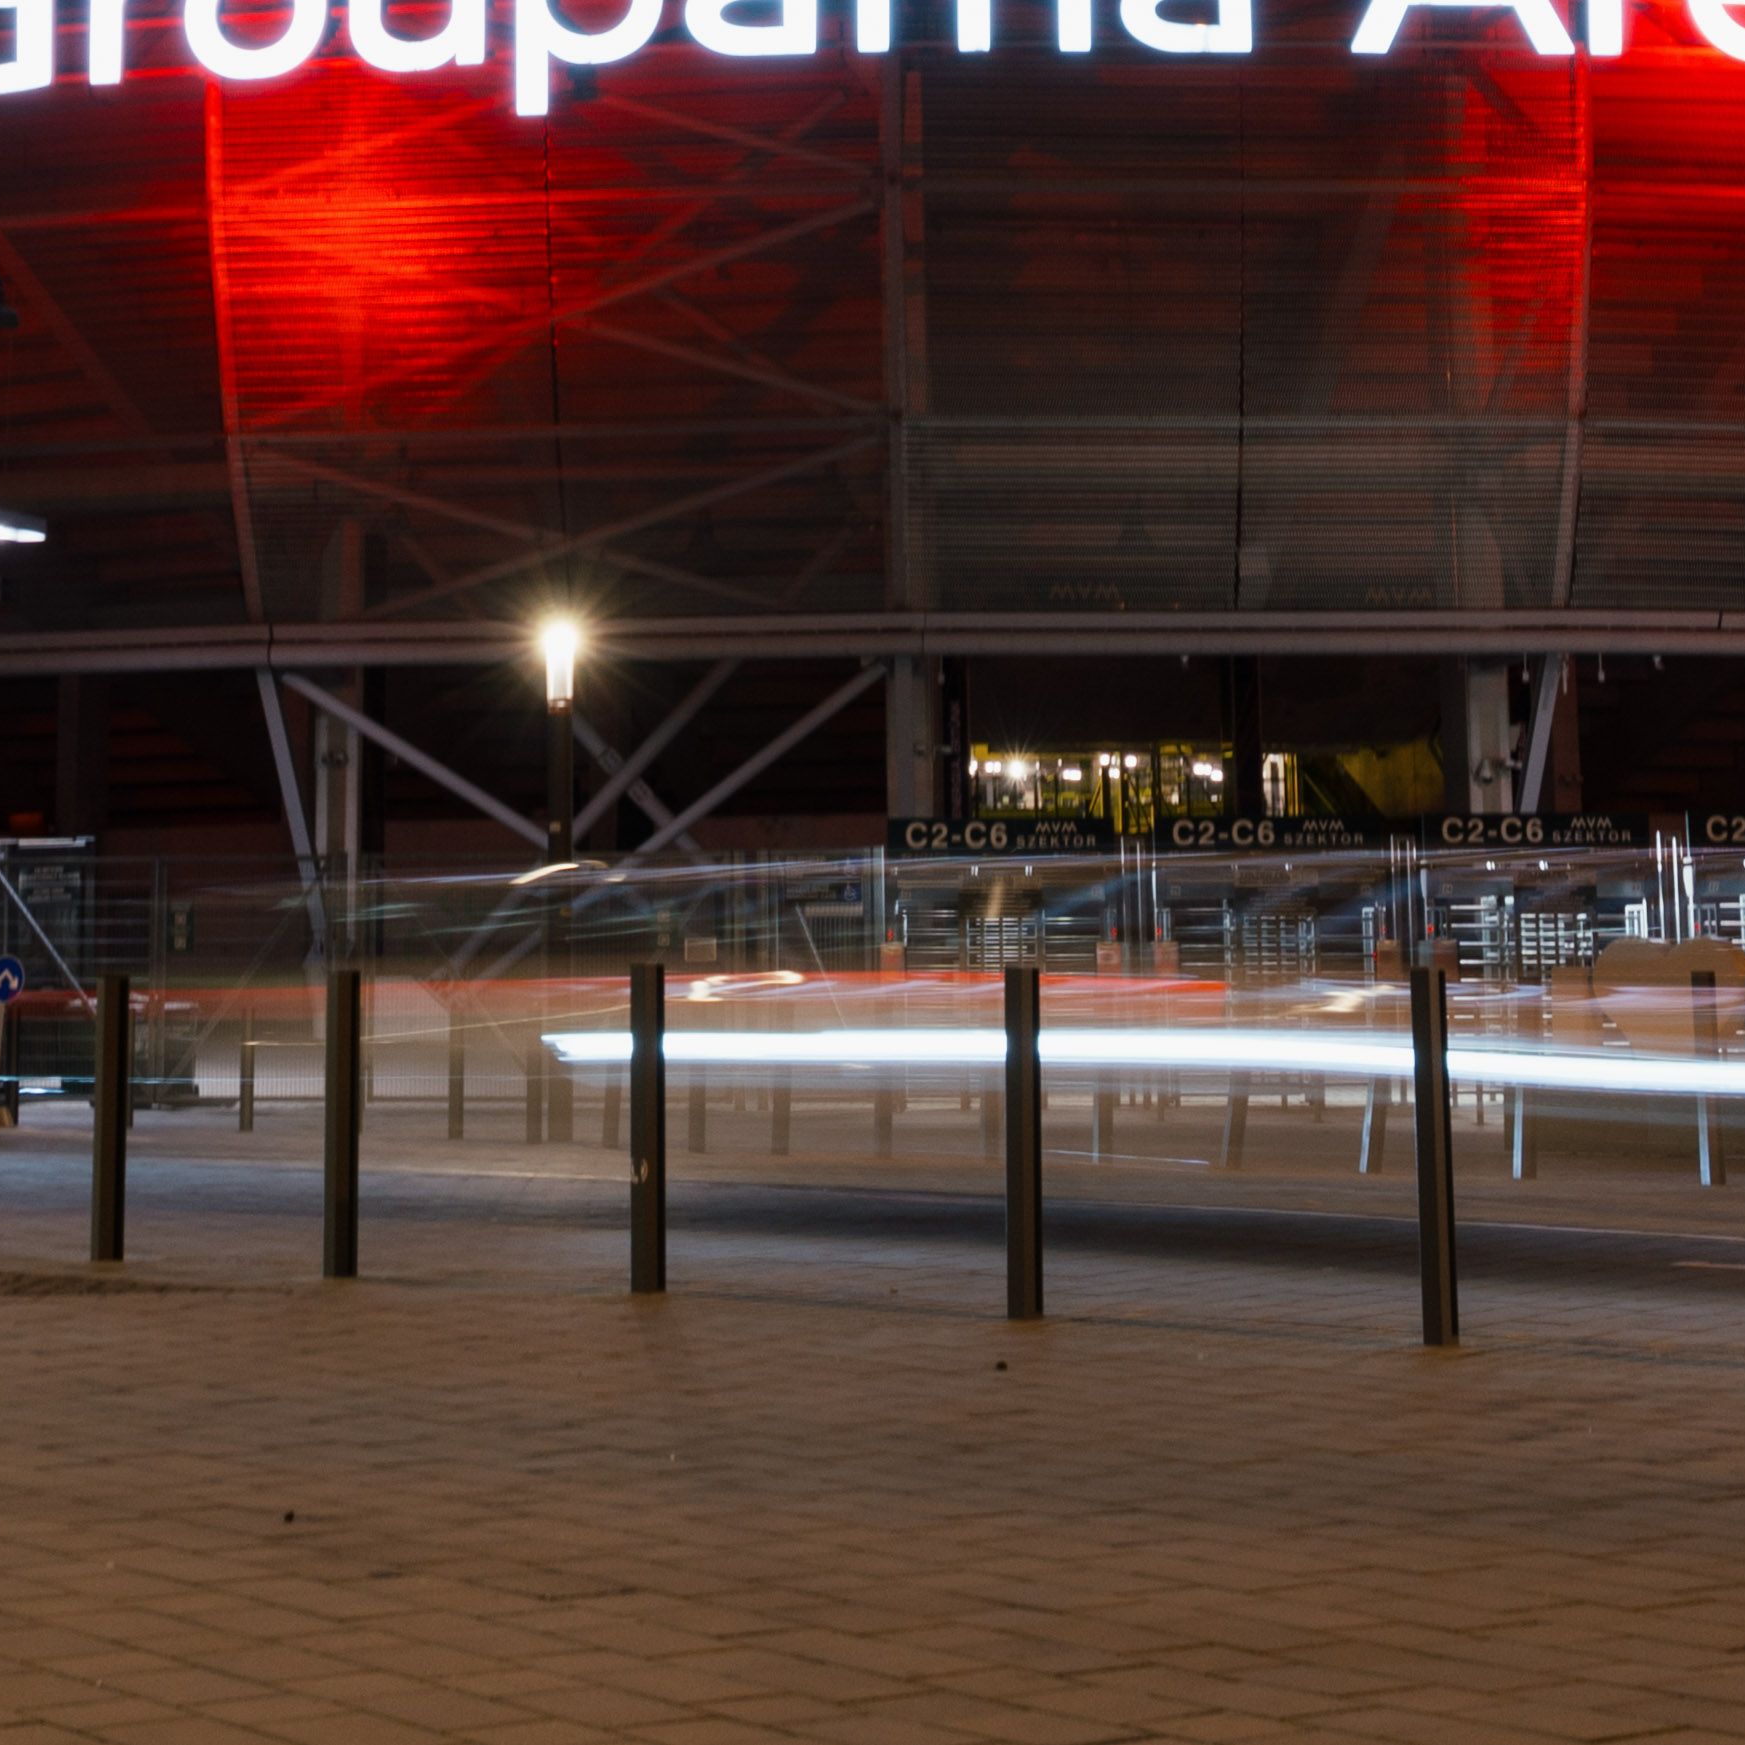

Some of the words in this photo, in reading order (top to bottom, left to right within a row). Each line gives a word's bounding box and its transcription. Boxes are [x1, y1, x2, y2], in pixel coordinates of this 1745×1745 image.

[1035, 821, 1078, 833] MVM
[1302, 819, 1345, 831] MVM
[1570, 816, 1613, 828] MVM
[905, 821, 1008, 849] C2-C6
[1172, 818, 1276, 847] C2-C6
[1441, 816, 1545, 844] C2-C6
[1552, 829, 1632, 843] SZEKTOR
[1016, 834, 1097, 848] SZEKTOR
[1283, 832, 1364, 845] SZEKTOR
